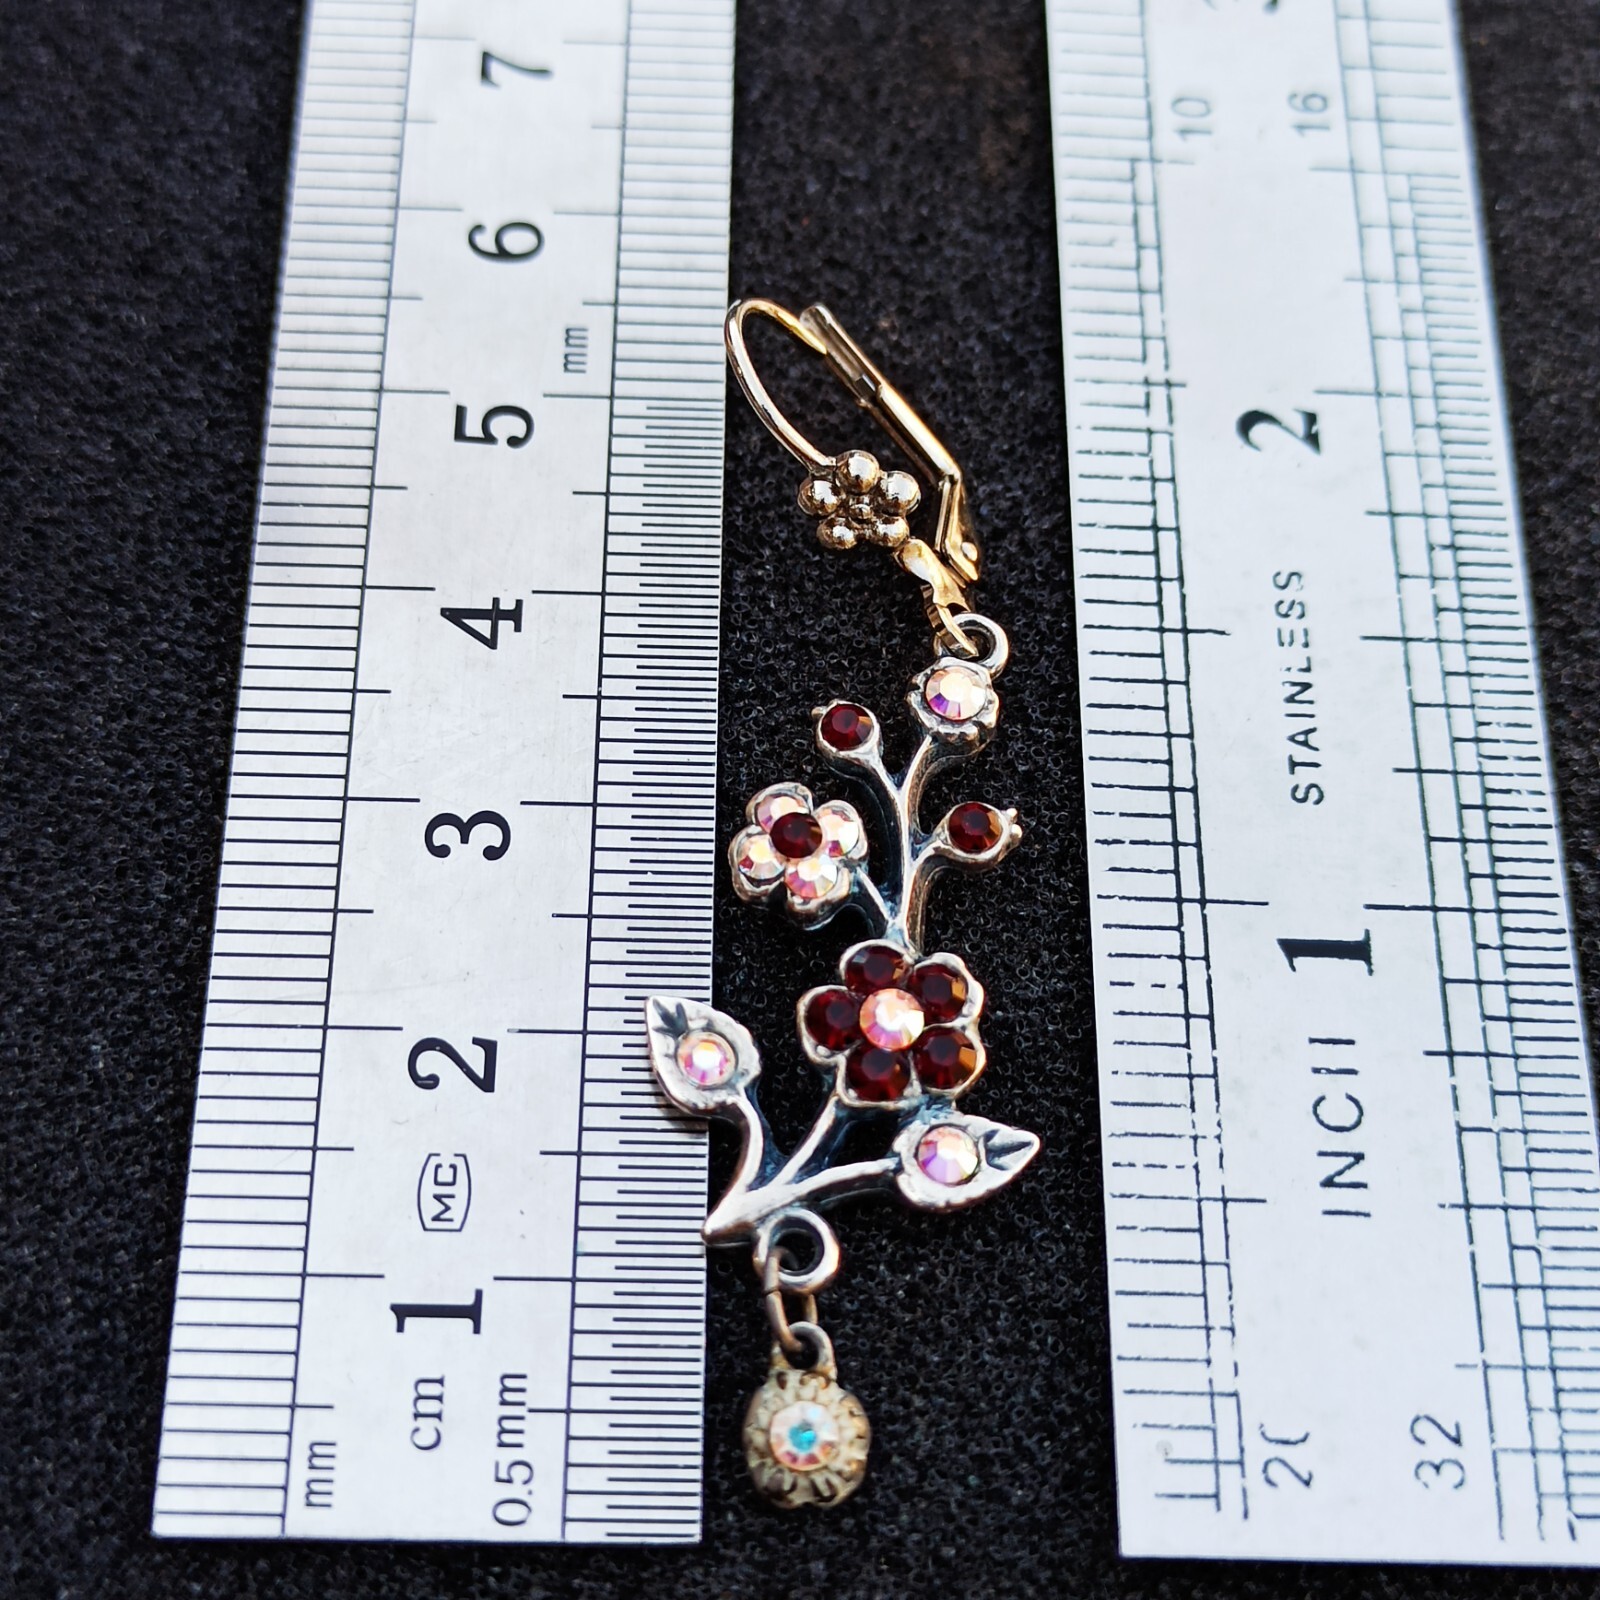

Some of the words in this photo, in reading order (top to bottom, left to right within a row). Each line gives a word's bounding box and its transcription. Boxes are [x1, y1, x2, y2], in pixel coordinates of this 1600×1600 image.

[480, 50, 554, 89] 7
[1171, 96, 1213, 141] 10
[1287, 92, 1331, 138] 16
[467, 221, 545, 264] 6
[563, 326, 588, 374] mm
[454, 404, 535, 450] 5
[1235, 408, 1322, 455] 2
[440, 597, 524, 651] 4
[1273, 570, 1325, 806] STAINLESS
[424, 810, 512, 861] 3
[1276, 928, 1374, 977] 1
[407, 1036, 498, 1094] 2
[390, 1289, 483, 1335] 1
[410, 1375, 446, 1451] cm
[304, 1440, 337, 1508] mm
[1410, 1414, 1466, 1489] 32
